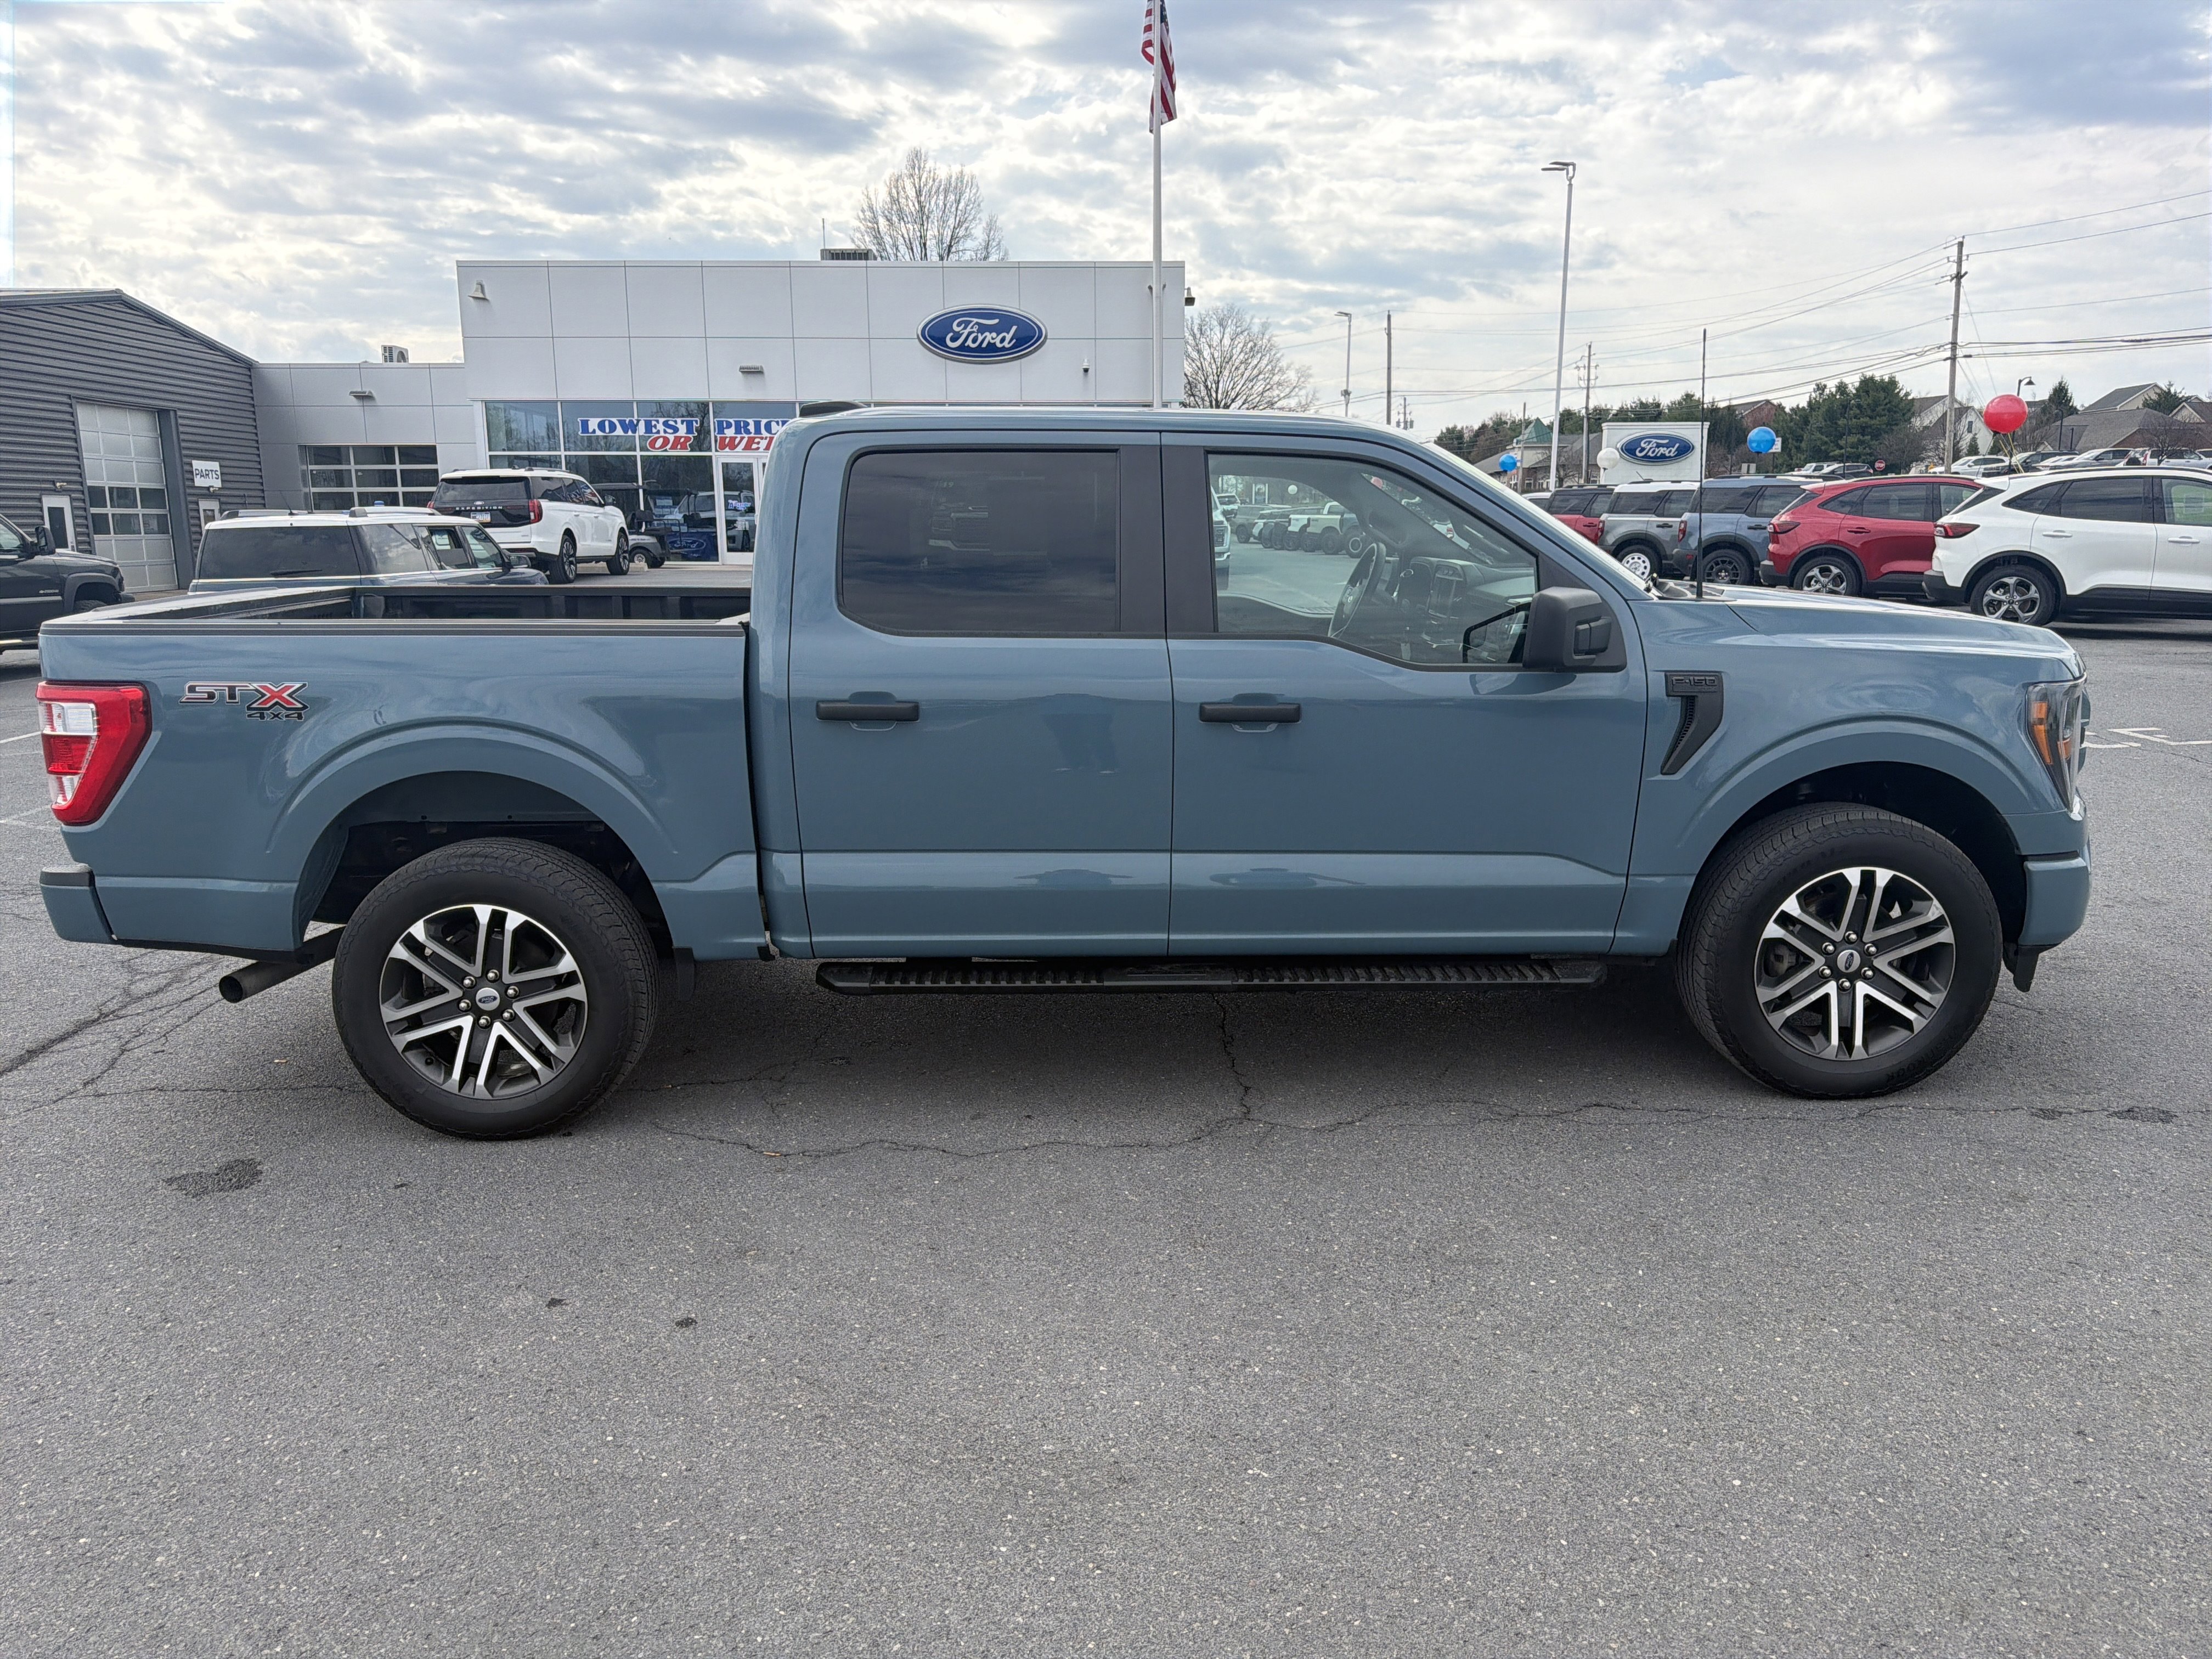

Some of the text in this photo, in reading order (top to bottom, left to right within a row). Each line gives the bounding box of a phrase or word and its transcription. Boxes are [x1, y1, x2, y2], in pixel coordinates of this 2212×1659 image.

[945, 317, 1018, 348] Ford
[579, 419, 791, 435] LOWEST PRIC
[647, 436, 692, 450] OR
[1635, 438, 1680, 457] Ford
[194, 468, 219, 480] PARTS
[178, 681, 309, 712] STX
